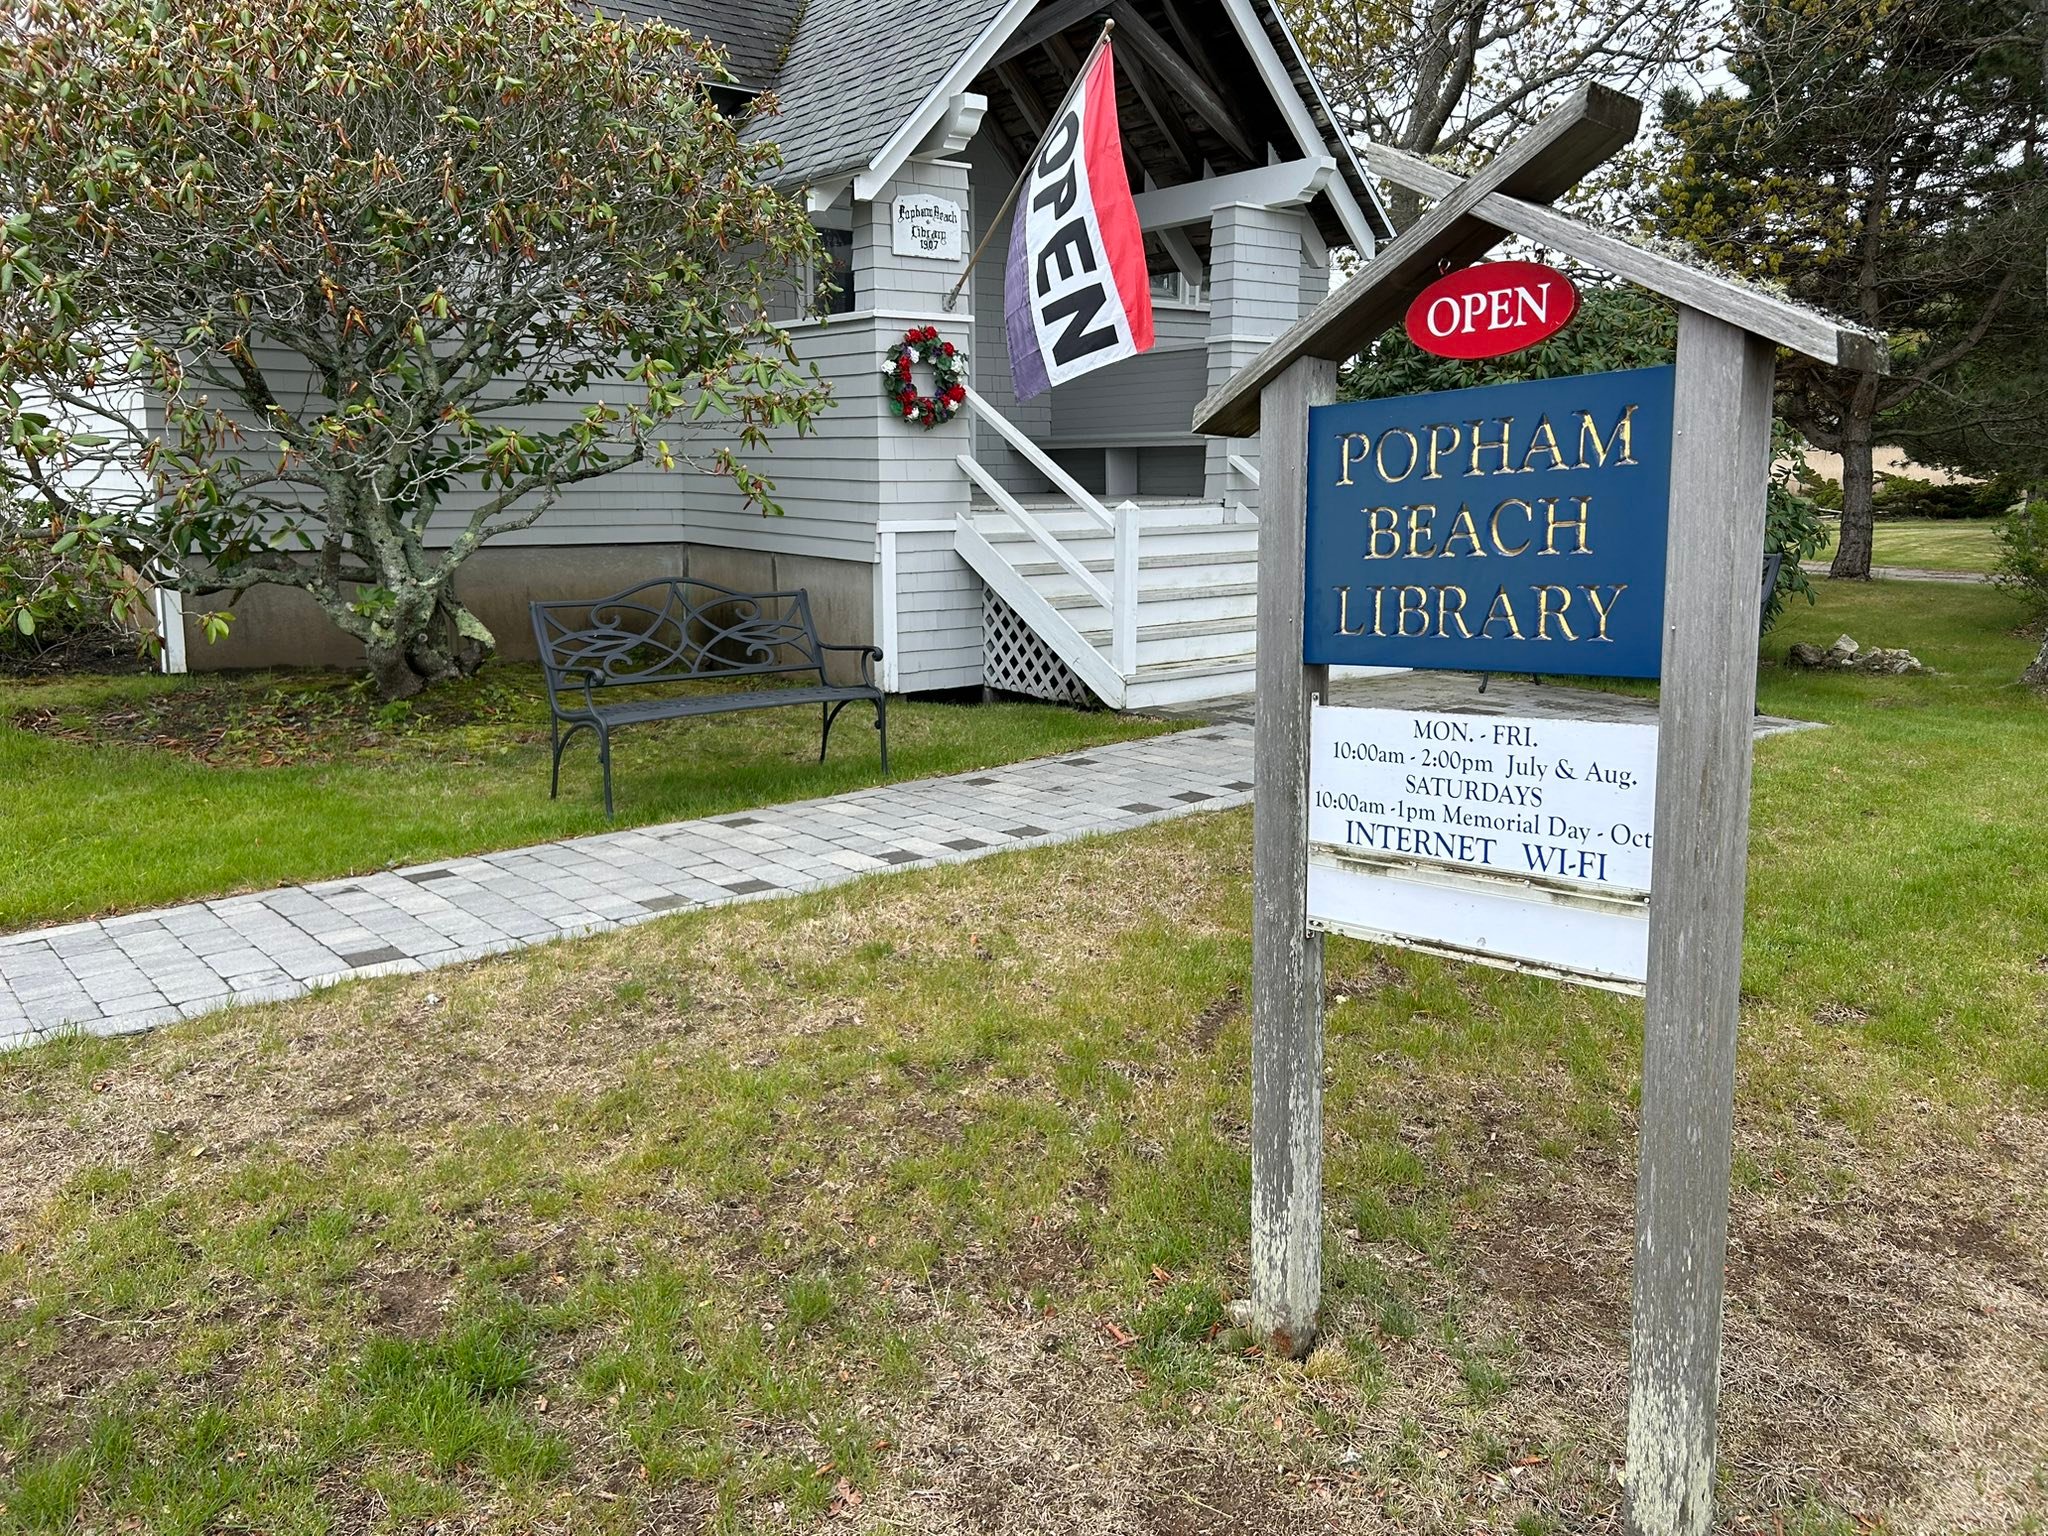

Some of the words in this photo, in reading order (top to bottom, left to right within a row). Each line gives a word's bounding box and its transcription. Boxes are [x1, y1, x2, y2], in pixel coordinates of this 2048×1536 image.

[897, 204, 933, 223] Popham
[933, 205, 958, 224] Beach
[911, 225, 947, 245] Library
[1033, 110, 1120, 367] OPEN
[920, 240, 939, 251] 1907
[1426, 282, 1552, 338] OPEN
[1333, 404, 1639, 486] POPHAM
[1360, 495, 1594, 561] BEACH
[1331, 584, 1629, 643] LIBRARY
[1413, 719, 1473, 743] MON.
[1492, 724, 1538, 748] FRI.
[1332, 741, 1405, 765] 10:00am
[1421, 749, 1494, 774] 2:00pm
[1505, 754, 1548, 782] July
[1554, 758, 1579, 781] &
[1584, 762, 1638, 790] Aug.
[1405, 774, 1543, 808] SATURDAYS
[1315, 790, 1385, 815] 10:00am
[1442, 804, 1541, 835] Memorial
[1547, 816, 1591, 845] Day
[1611, 823, 1653, 849] Oct
[1345, 819, 1497, 865] INTERNET
[1522, 842, 1609, 882] WI-FI
